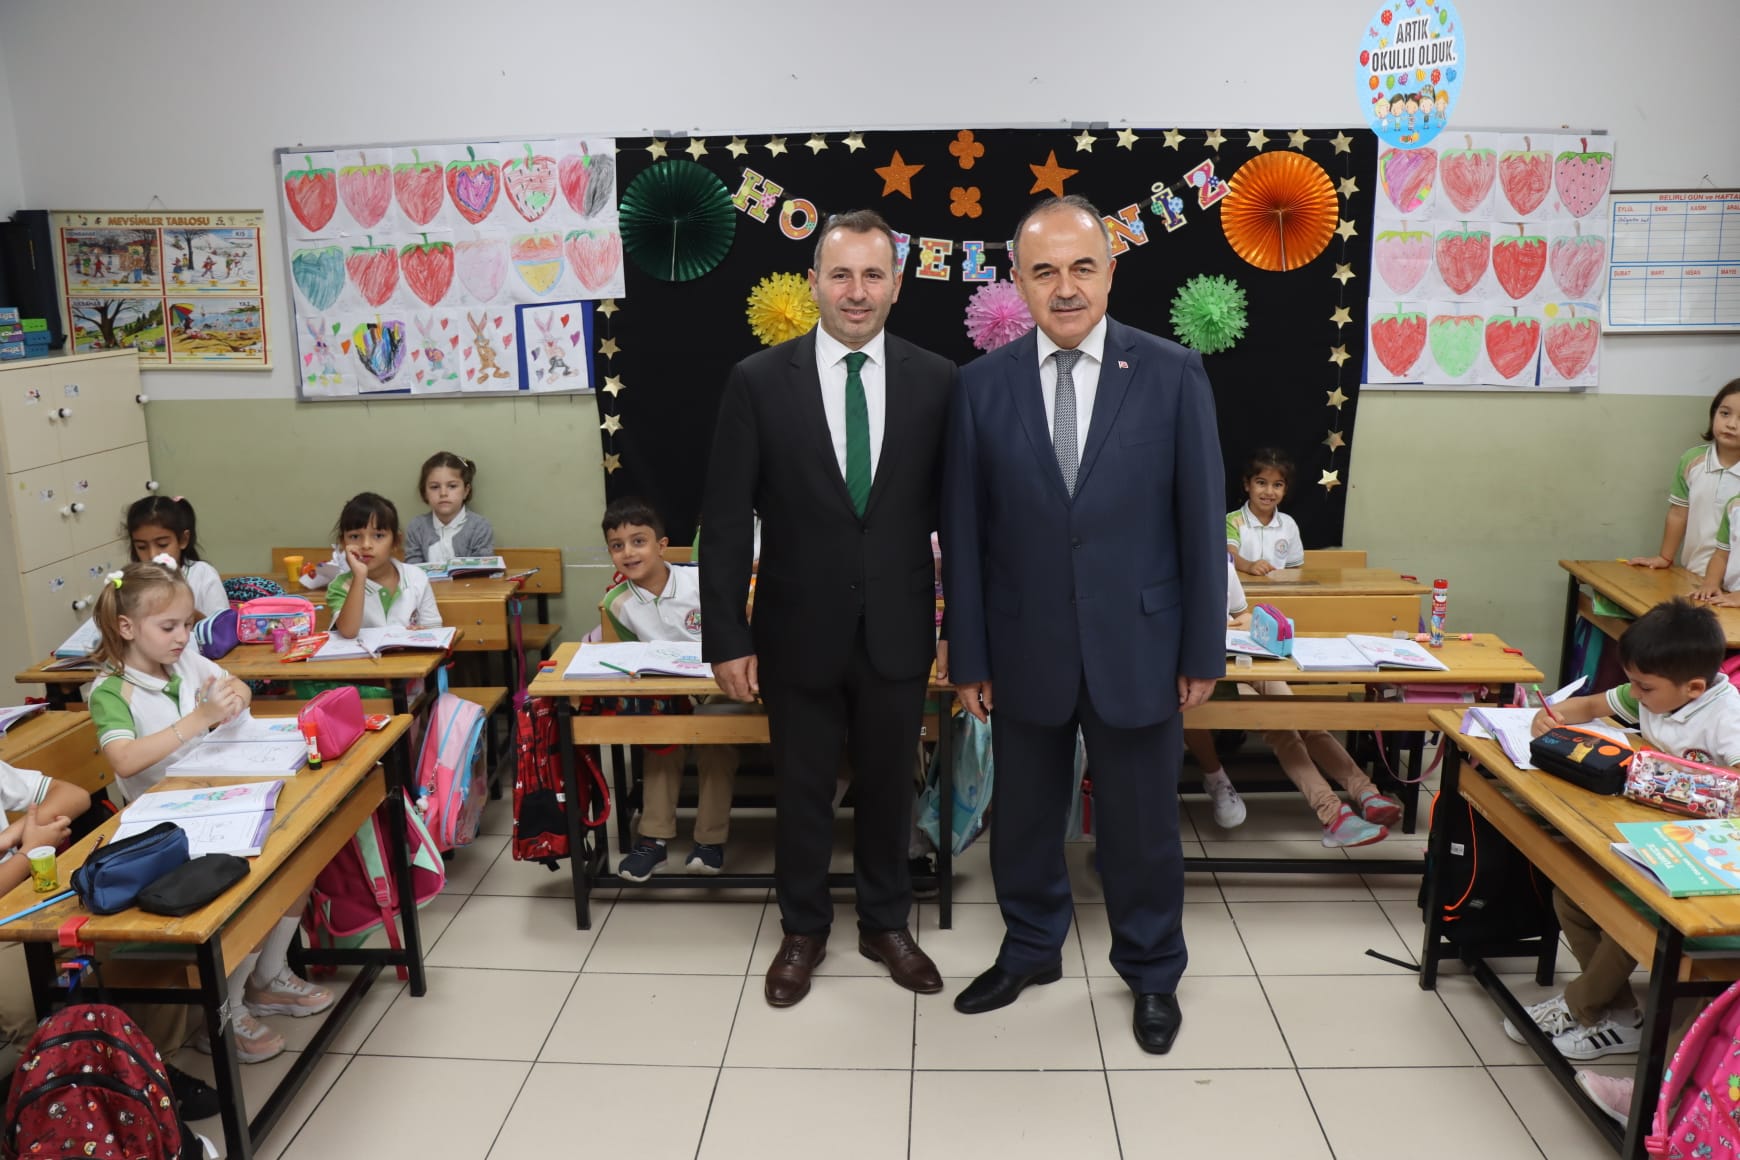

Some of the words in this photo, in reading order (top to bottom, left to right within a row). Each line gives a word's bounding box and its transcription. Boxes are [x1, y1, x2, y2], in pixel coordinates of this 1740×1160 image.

[1396, 18, 1429, 44] ARTIK
[1371, 46, 1415, 73] OKULLU
[1419, 39, 1456, 66] OLDUK.
[730, 167, 819, 240] HO
[107, 214, 164, 226] MEVSİMLER
[166, 216, 210, 226] TABLOSU
